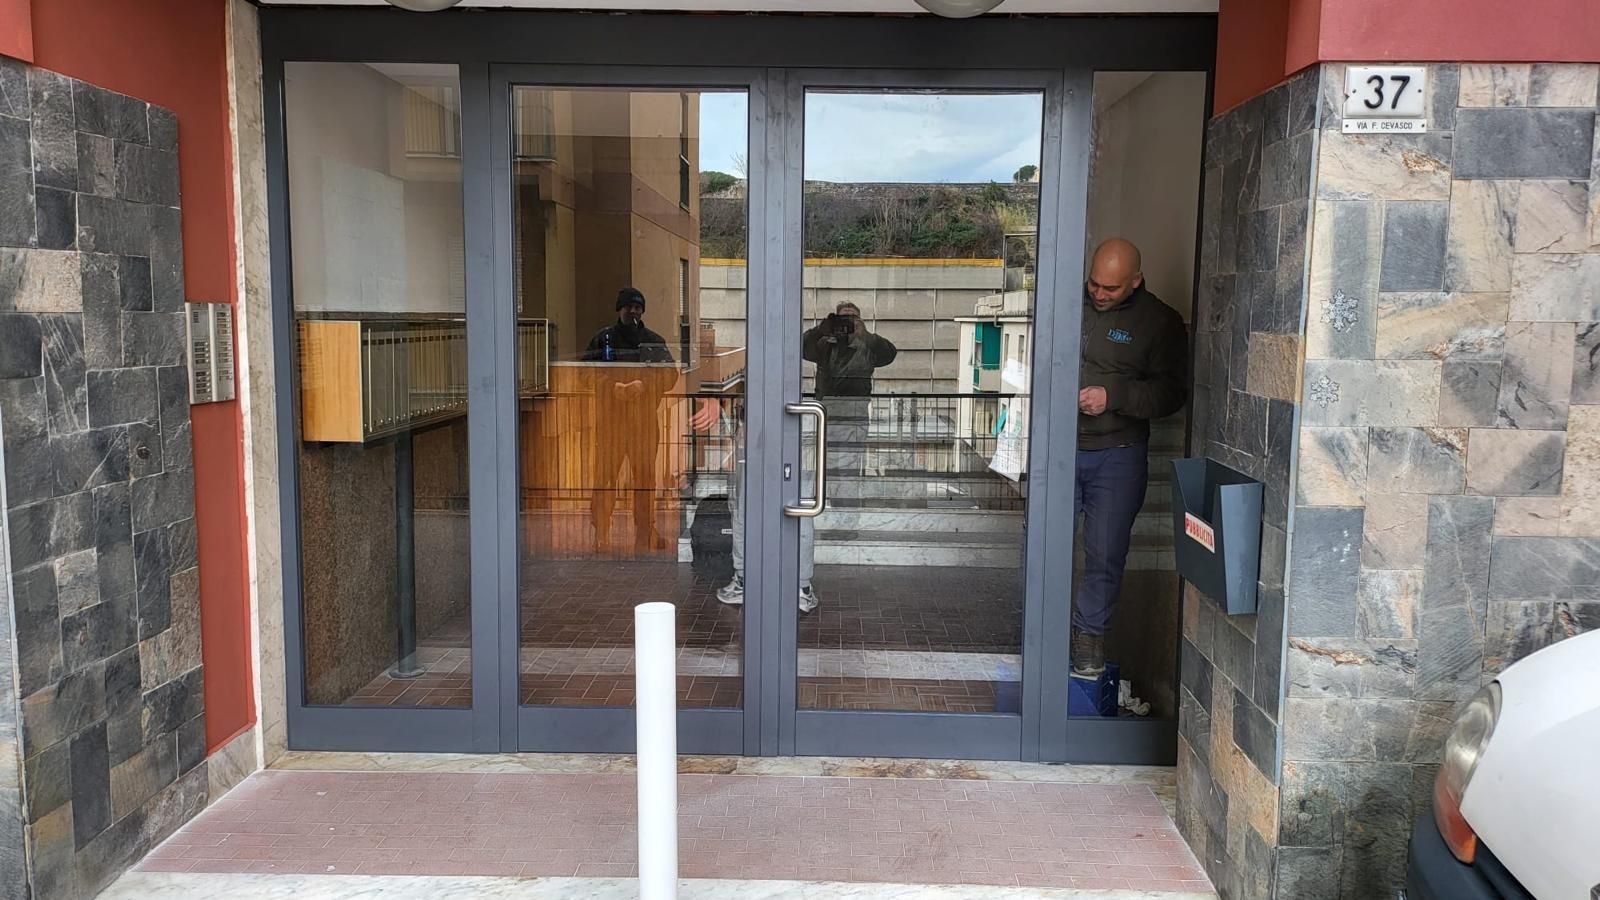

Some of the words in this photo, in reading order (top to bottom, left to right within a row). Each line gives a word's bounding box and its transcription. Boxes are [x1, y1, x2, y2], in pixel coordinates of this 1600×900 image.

[1364, 75, 1411, 110] 37
[1356, 122, 1368, 130] VIA
[1371, 122, 1379, 130] F.
[1380, 121, 1413, 130] CEVASCO
